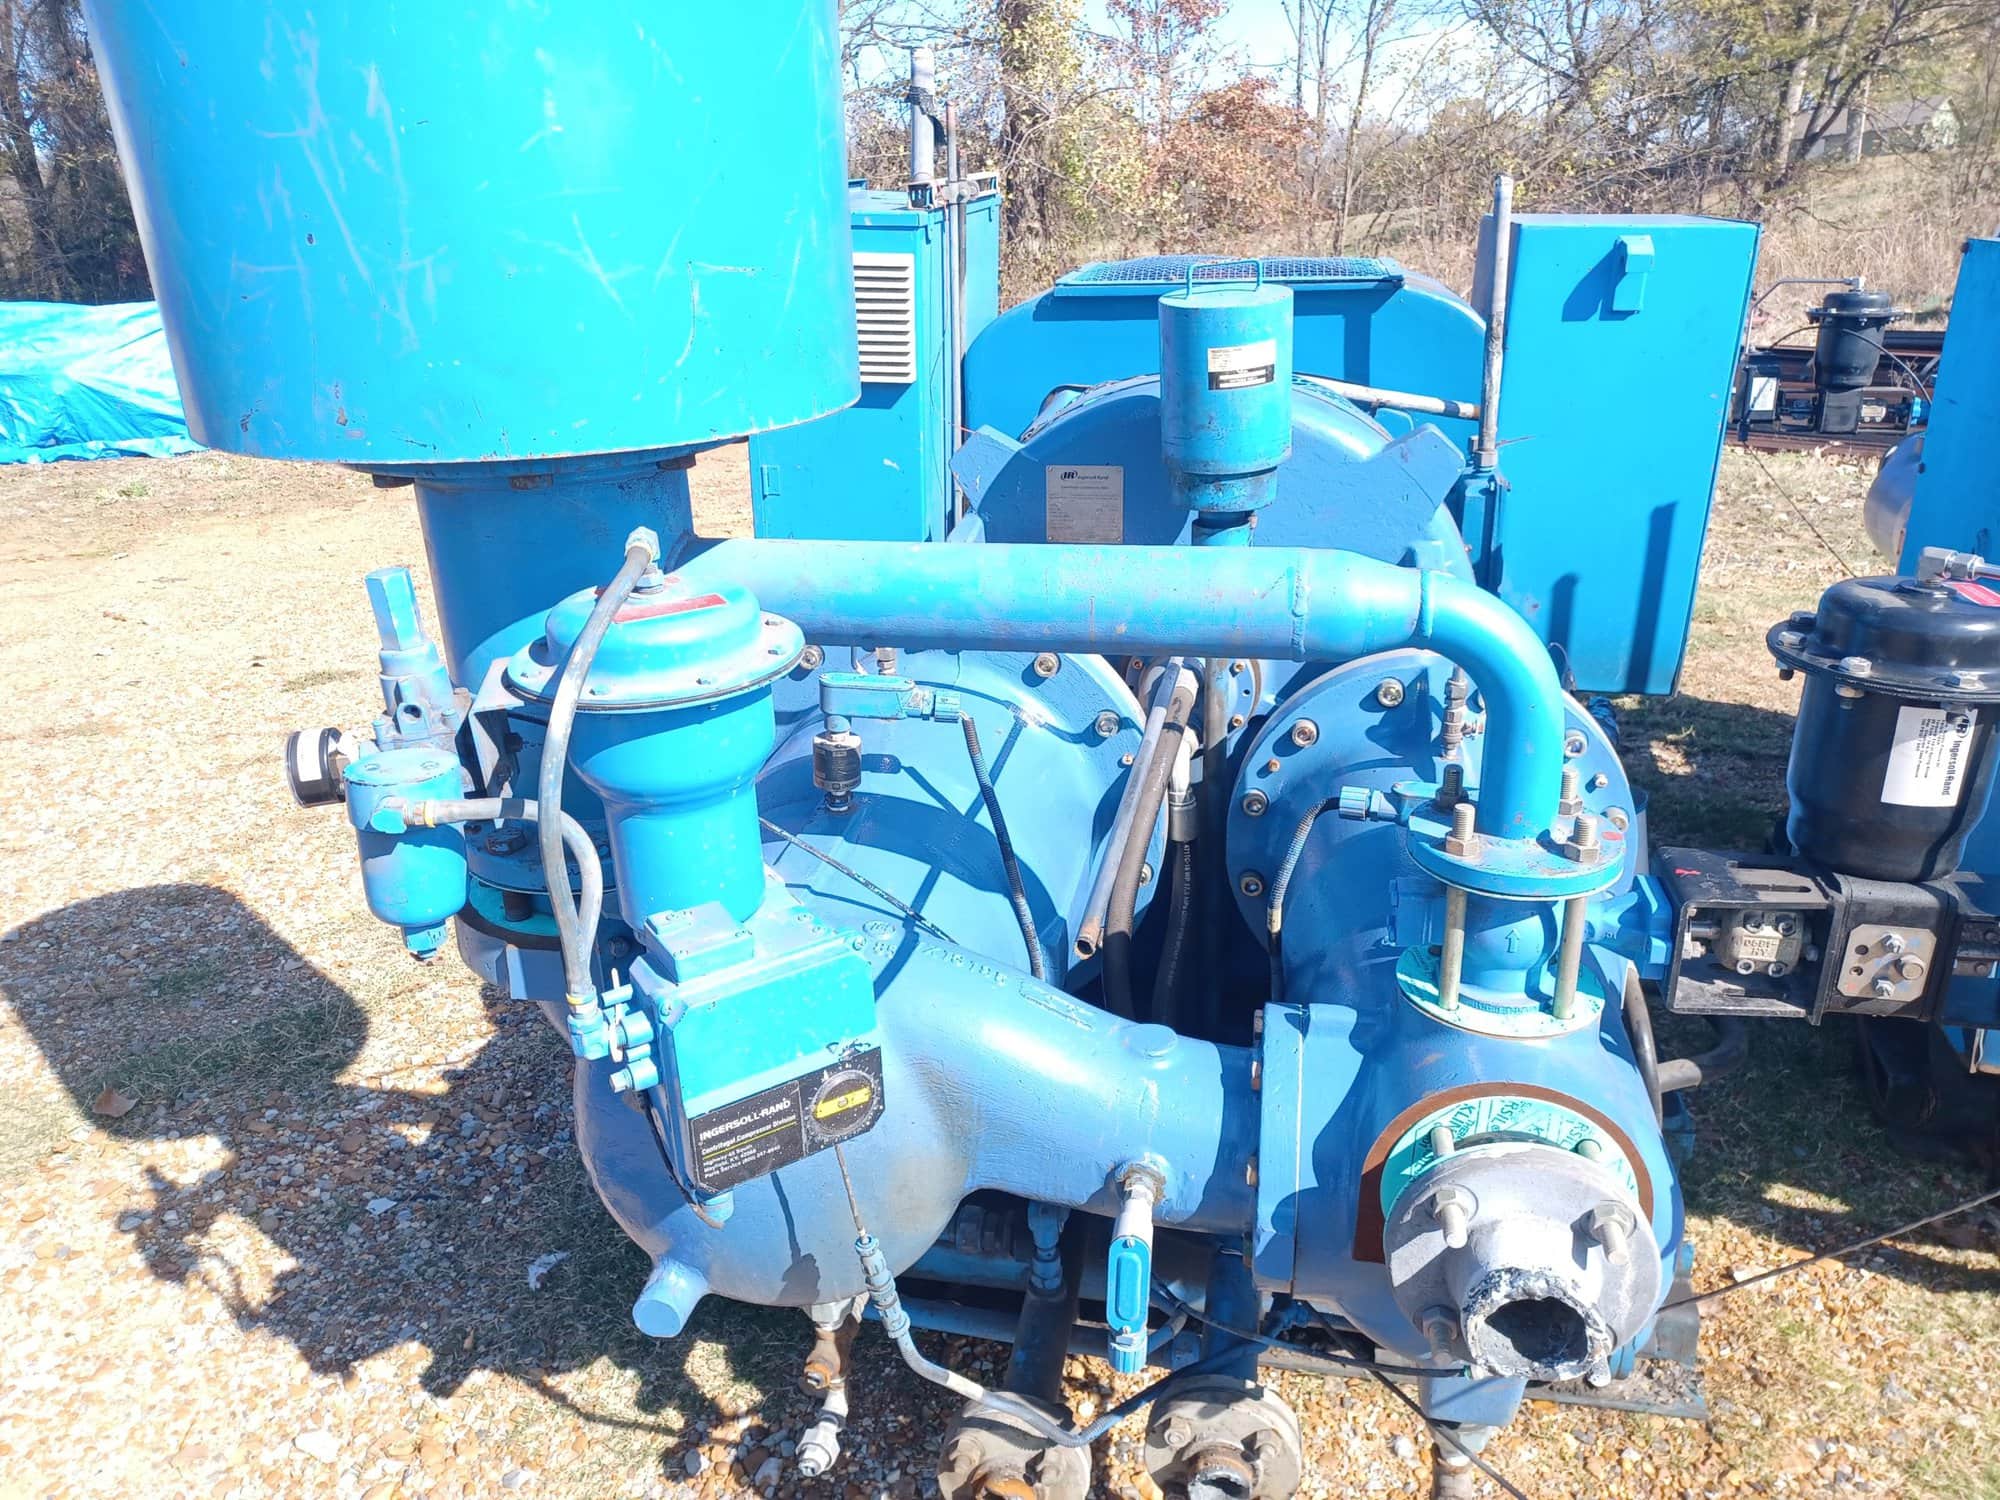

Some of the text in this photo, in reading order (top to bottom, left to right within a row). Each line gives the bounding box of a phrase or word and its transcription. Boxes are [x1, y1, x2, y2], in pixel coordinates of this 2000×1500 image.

[1946, 740, 1963, 775] Ingersoll
[1941, 775, 1955, 796] Rand
[699, 1100, 791, 1141] INGERSOLL-RAND
[704, 1168, 720, 1179] Parts
[720, 1160, 742, 1173] Service
